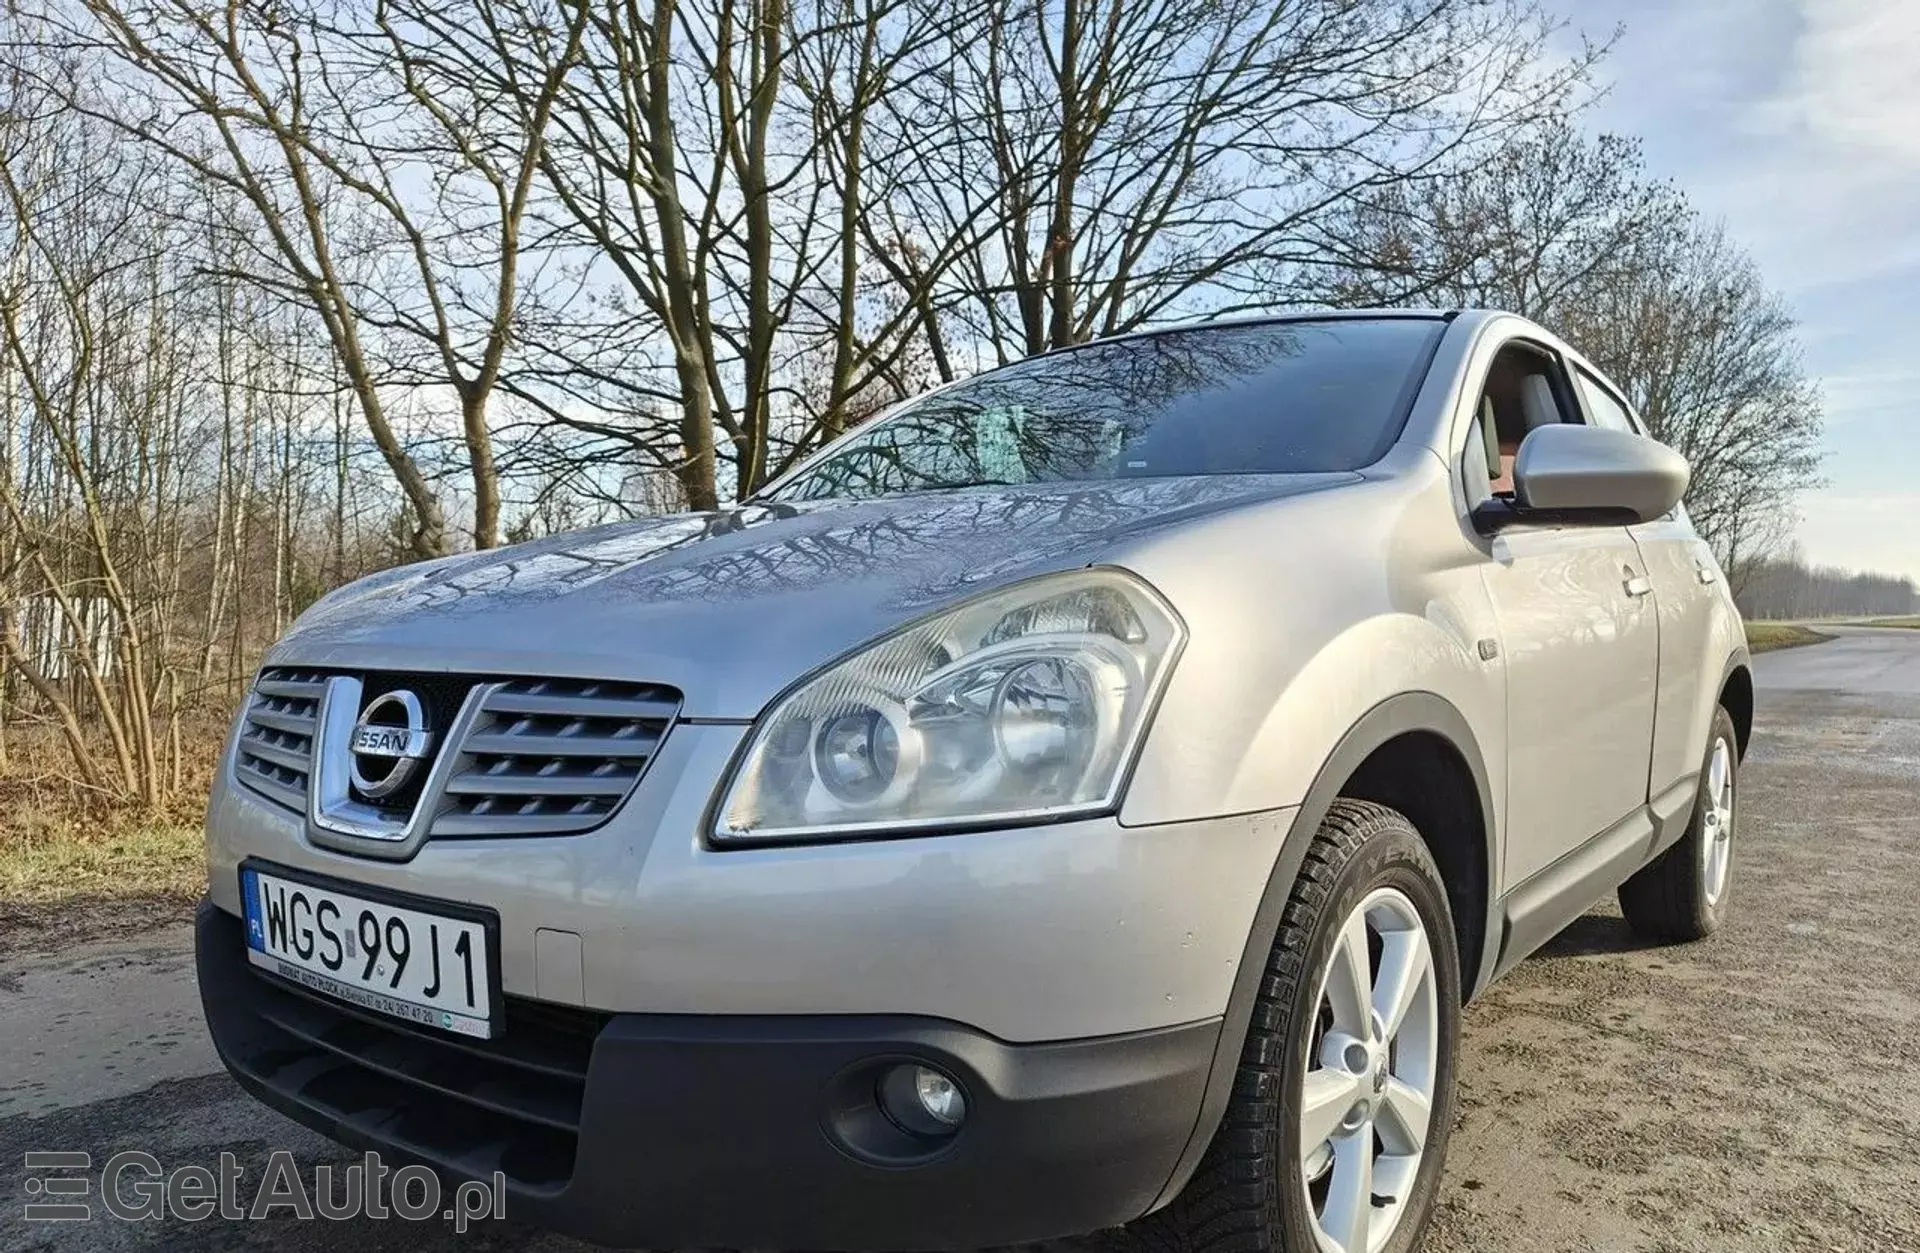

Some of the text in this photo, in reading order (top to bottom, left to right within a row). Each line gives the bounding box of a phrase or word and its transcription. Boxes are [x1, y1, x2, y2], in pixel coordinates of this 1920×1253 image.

[250, 918, 262, 938] PL
[264, 882, 475, 1008] WGS 99J1
